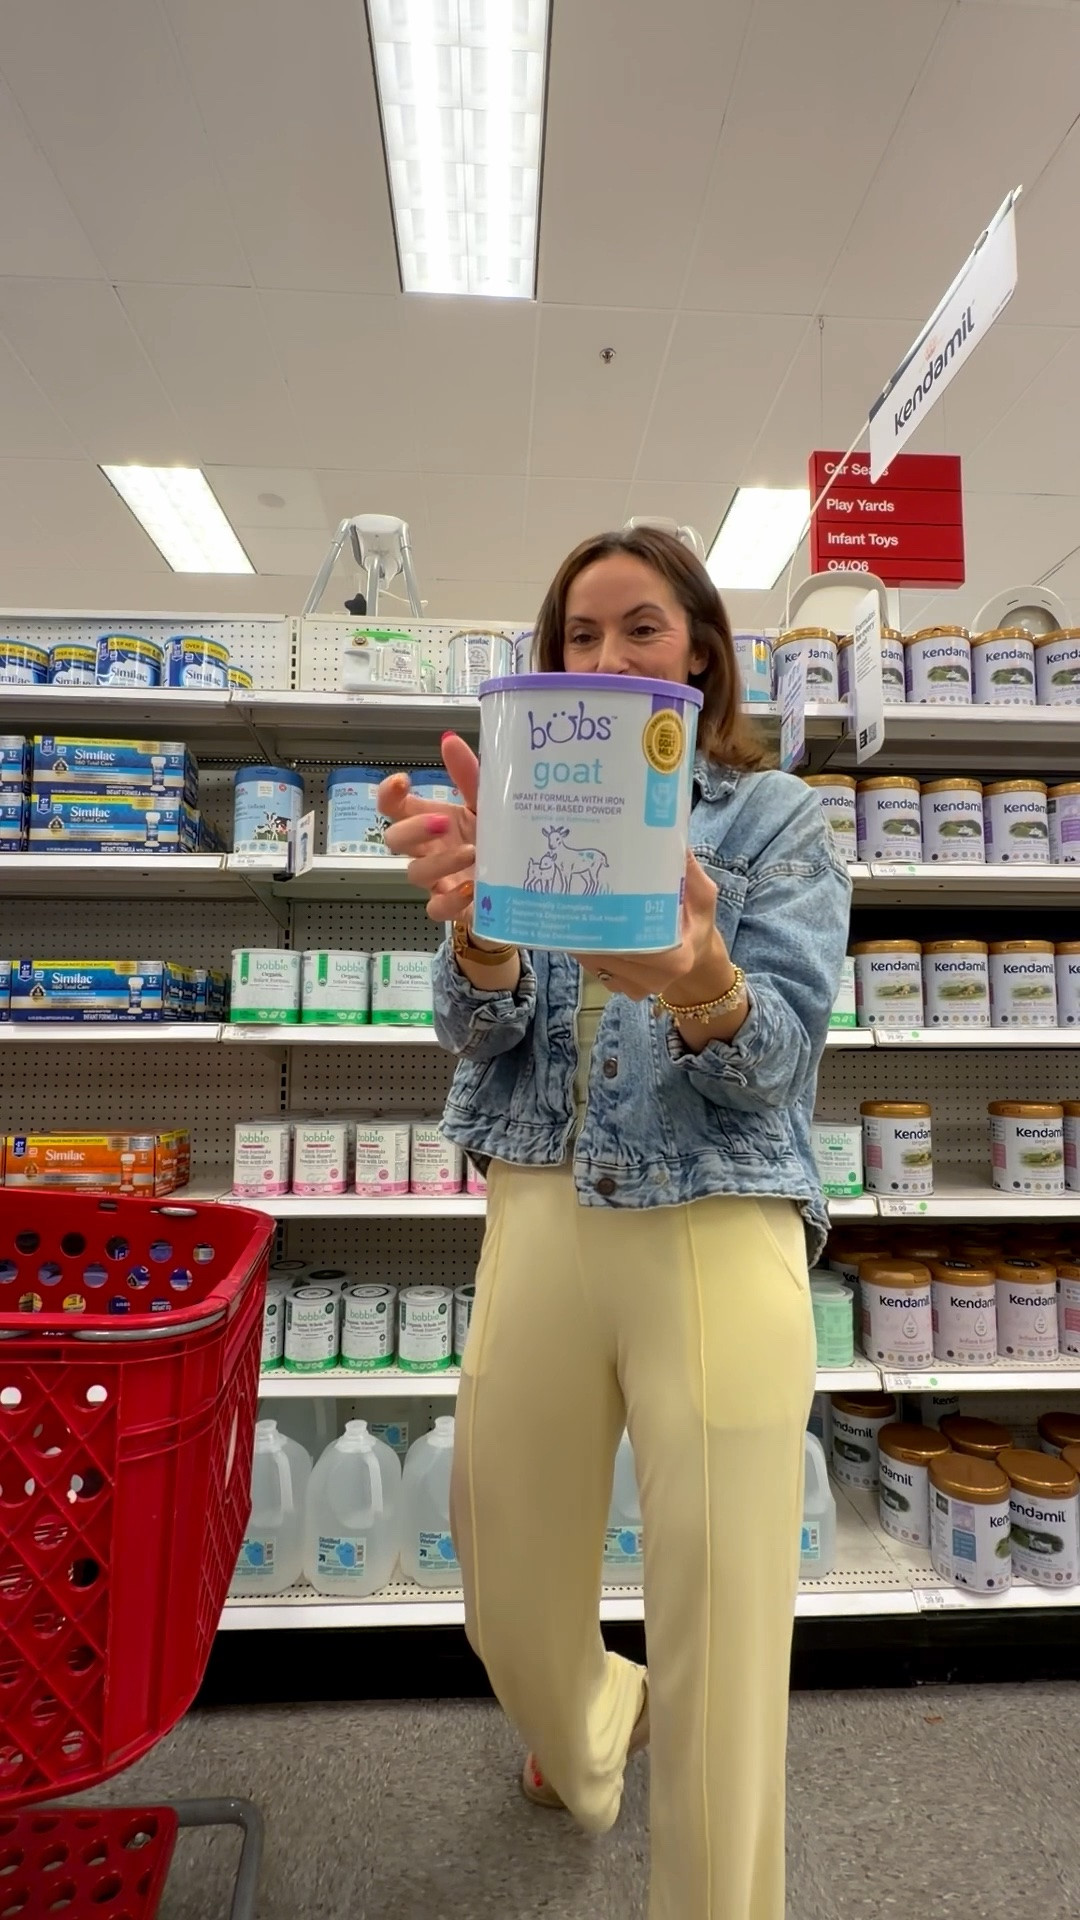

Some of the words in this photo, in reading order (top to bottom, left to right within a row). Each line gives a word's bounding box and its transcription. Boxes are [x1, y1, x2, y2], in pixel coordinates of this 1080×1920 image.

[824, 463, 849, 475] Car
[826, 499, 854, 513] Play
[857, 500, 895, 512] Yards
[828, 533, 866, 546] Infant
[868, 533, 899, 548] Toys
[111, 666, 148, 683] Similac
[74, 749, 116, 762] Similac
[171, 756, 180, 764] 12
[534, 758, 603, 790] goat
[512, 792, 538, 801] INFANT
[540, 793, 579, 803] FORMULA
[581, 795, 603, 805] WITH
[605, 797, 625, 806] IRON
[70, 806, 110, 819] Similac
[165, 811, 174, 819] 12
[514, 802, 533, 811] GOAT
[534, 803, 584, 814] MILK-BASED
[586, 806, 622, 816] POWDER
[256, 959, 288, 971] bobbie
[335, 961, 364, 972] bobbie
[397, 961, 427, 972] bobbie
[51, 972, 93, 985] Similac
[148, 976, 157, 984] 12
[819, 1132, 852, 1145] bobbie
[45, 1149, 86, 1161] Similac
[297, 1310, 326, 1321] bobbie
[350, 1308, 378, 1319] bobbie
[412, 1310, 439, 1321] bobbie
[1009, 1500, 1066, 1523] endamil
[319, 1536, 341, 1544] Distilled
[419, 1532, 442, 1540] Distilled
